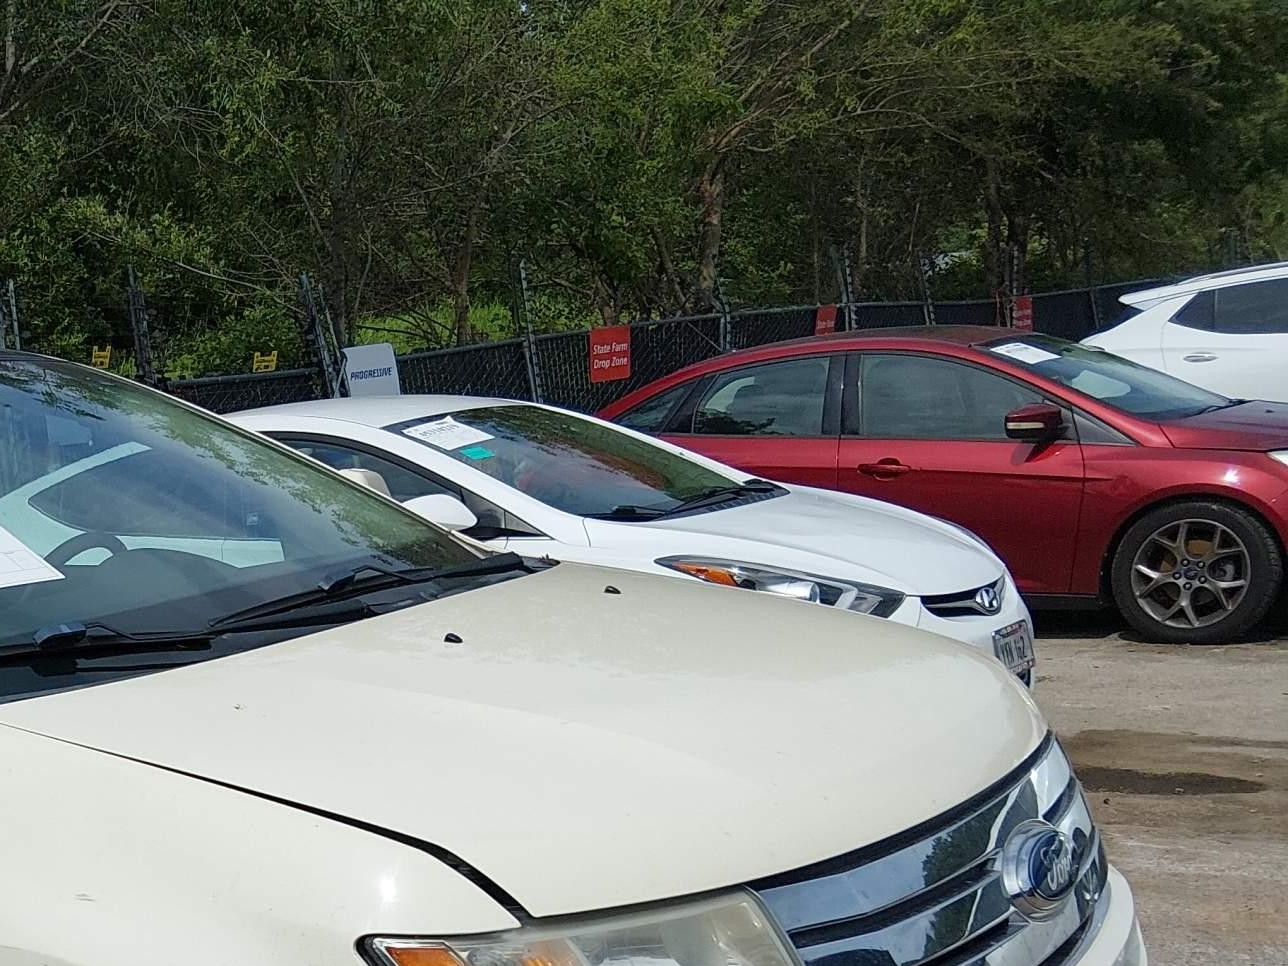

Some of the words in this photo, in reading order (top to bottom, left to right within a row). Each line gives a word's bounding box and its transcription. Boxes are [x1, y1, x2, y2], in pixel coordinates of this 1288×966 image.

[592, 344, 611, 355] State
[611, 342, 628, 353] Farm
[593, 359, 611, 369] Drop
[611, 356, 628, 367] Zone
[350, 366, 393, 381] PROGRESSIVE
